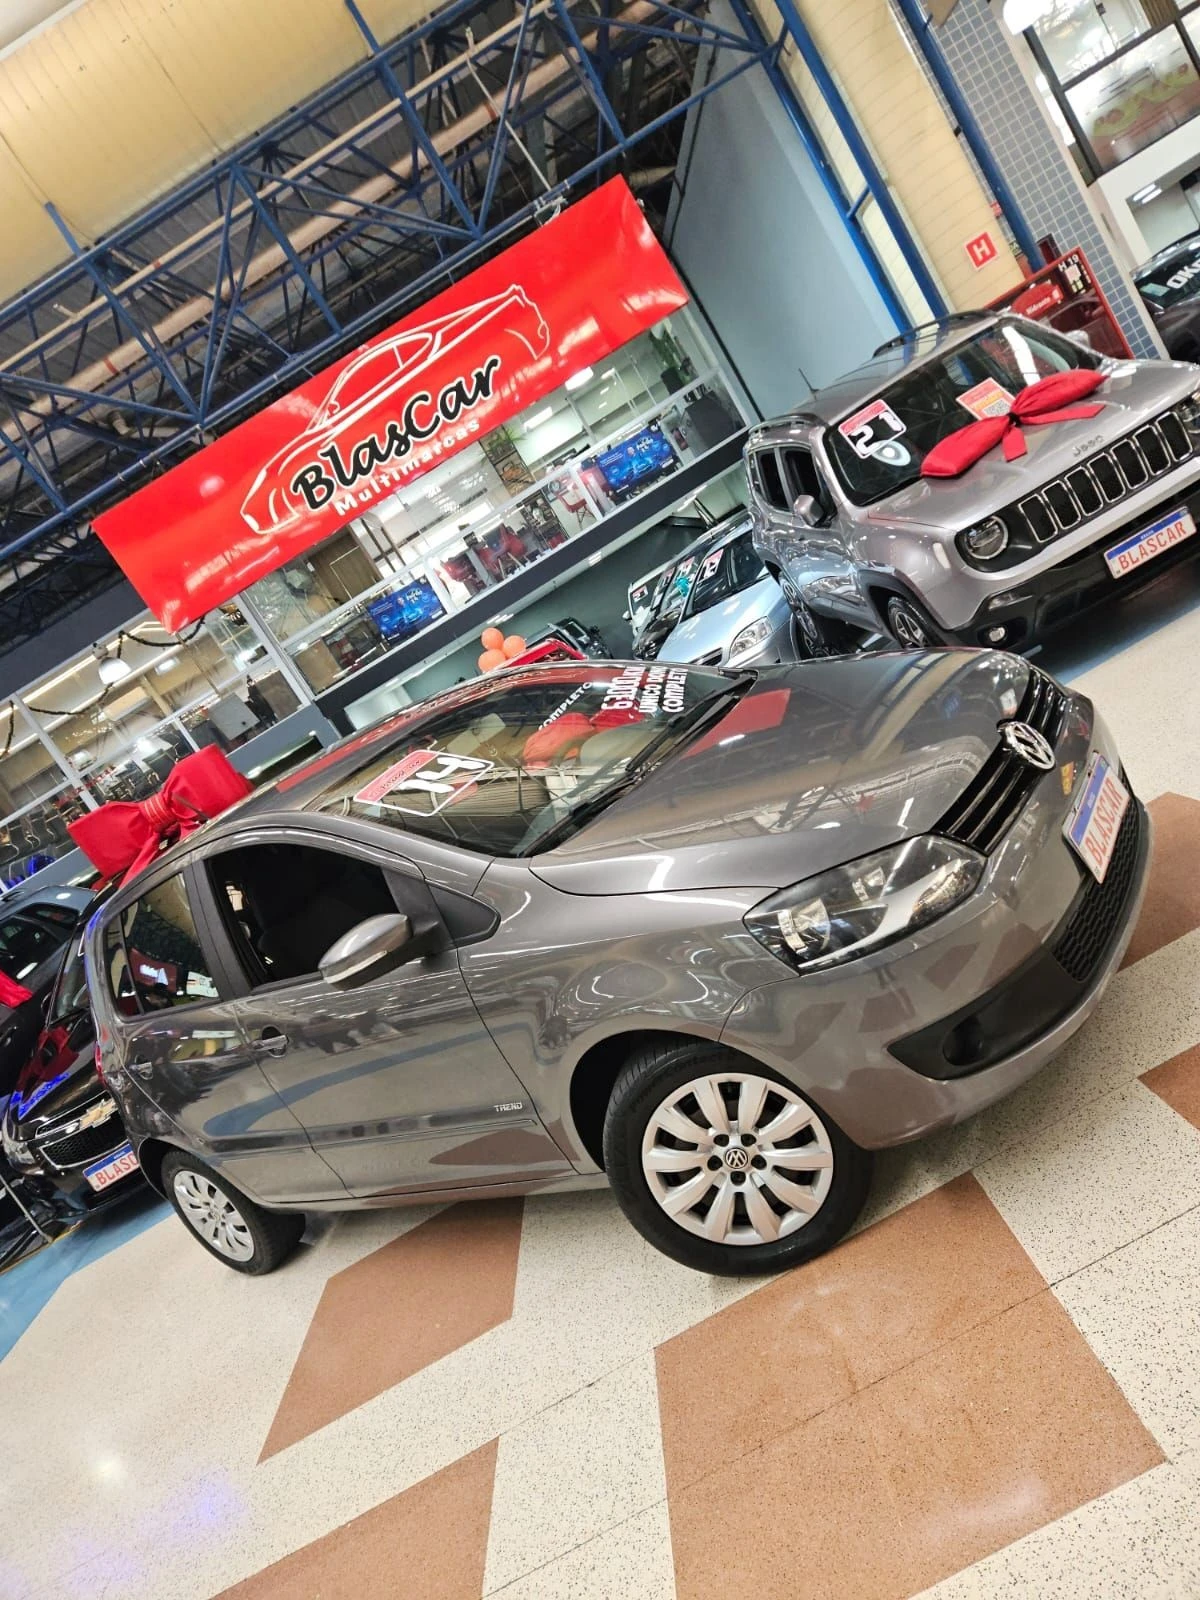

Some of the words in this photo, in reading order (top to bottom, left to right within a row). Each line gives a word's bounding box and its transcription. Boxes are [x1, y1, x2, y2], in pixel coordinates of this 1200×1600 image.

[291, 356, 500, 511] BlasCar
[333, 419, 480, 516] Multimarcas
[850, 410, 904, 454] 21
[1117, 520, 1187, 571] BLASCAR
[1084, 777, 1124, 867] BLASCAR
